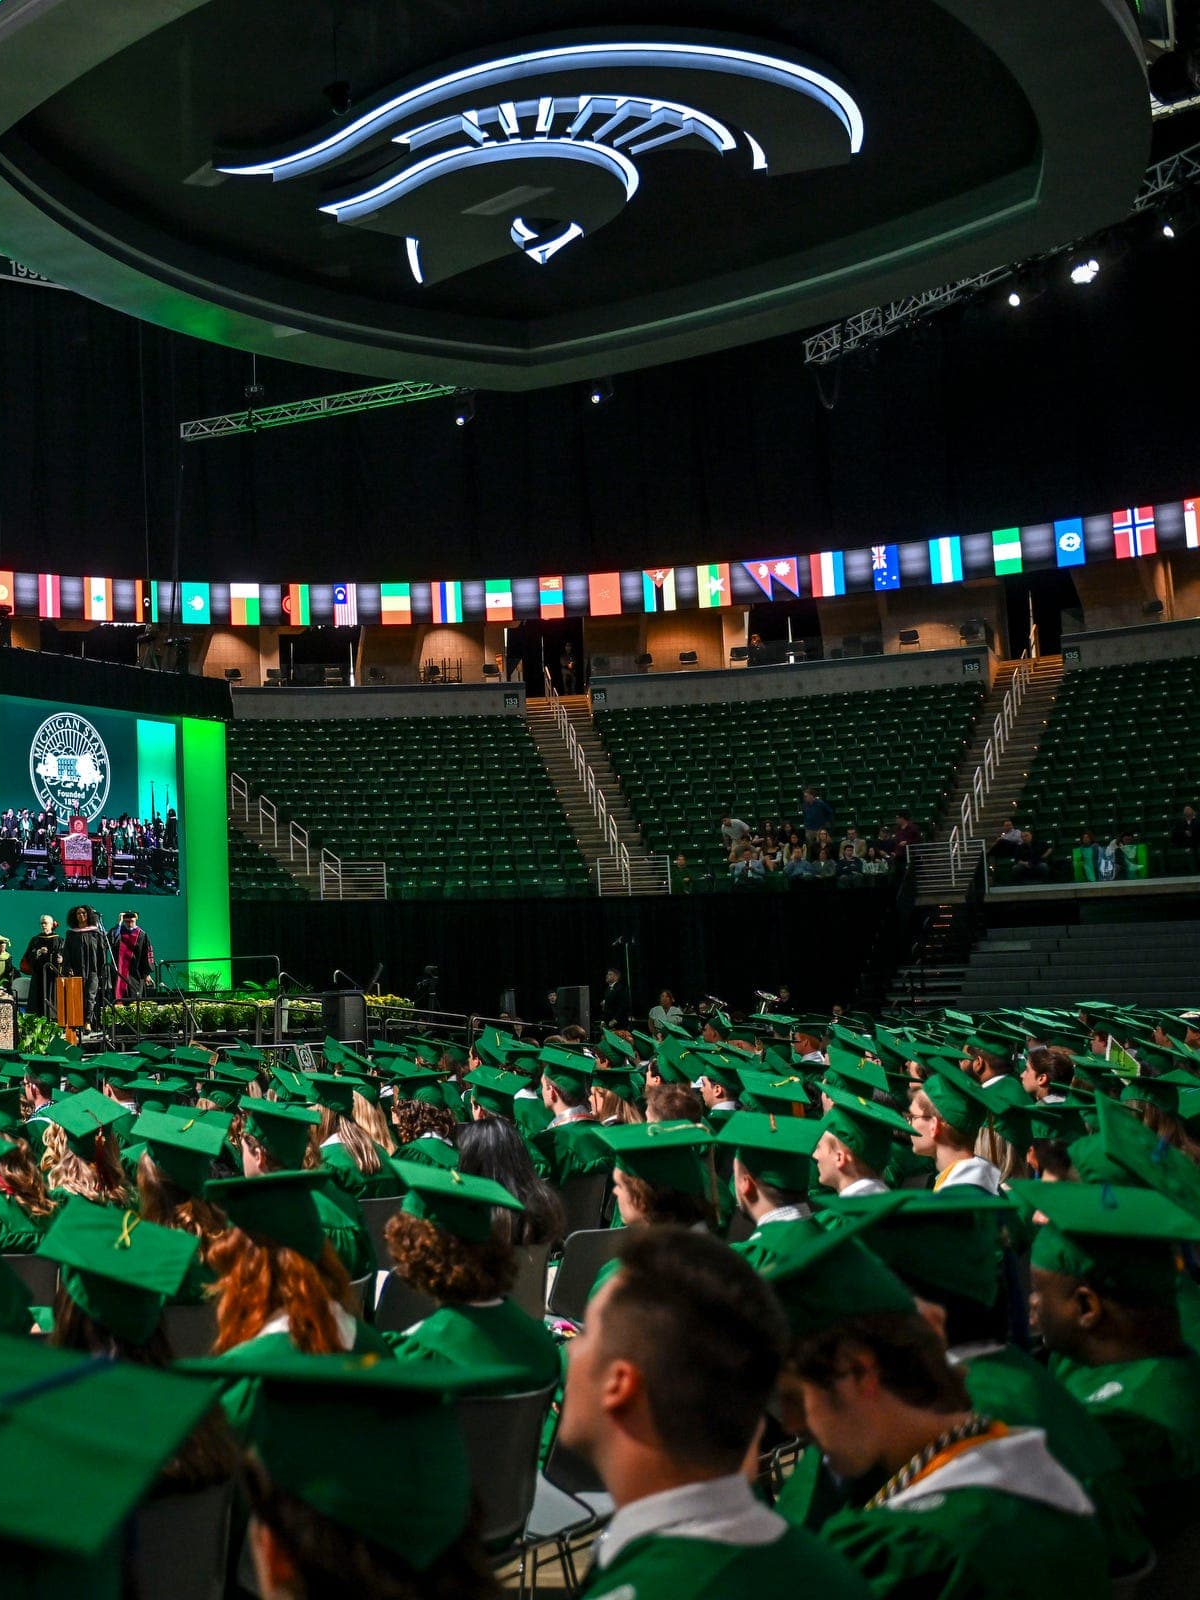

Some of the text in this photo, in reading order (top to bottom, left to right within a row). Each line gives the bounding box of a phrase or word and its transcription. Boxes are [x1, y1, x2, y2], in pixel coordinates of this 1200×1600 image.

[964, 663, 980, 671] 135
[34, 718, 106, 765] MICHIGAN STATE
[57, 789, 86, 799] Founded
